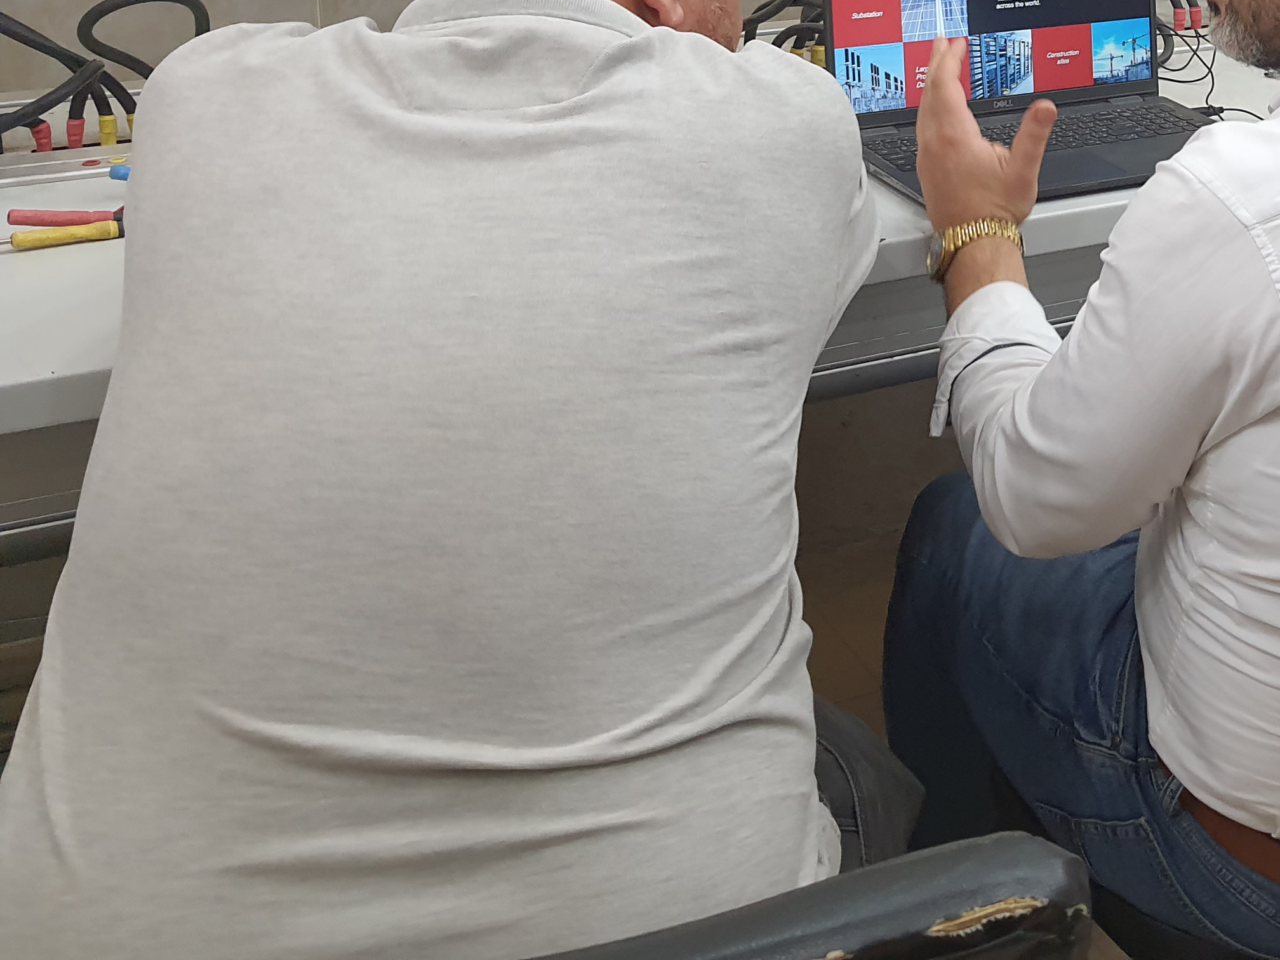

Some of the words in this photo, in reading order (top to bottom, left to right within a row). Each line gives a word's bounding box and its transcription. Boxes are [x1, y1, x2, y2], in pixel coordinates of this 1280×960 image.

[851, 11, 883, 19] Substation
[1046, 50, 1080, 59] Construction
[993, 99, 1014, 108] DELL
